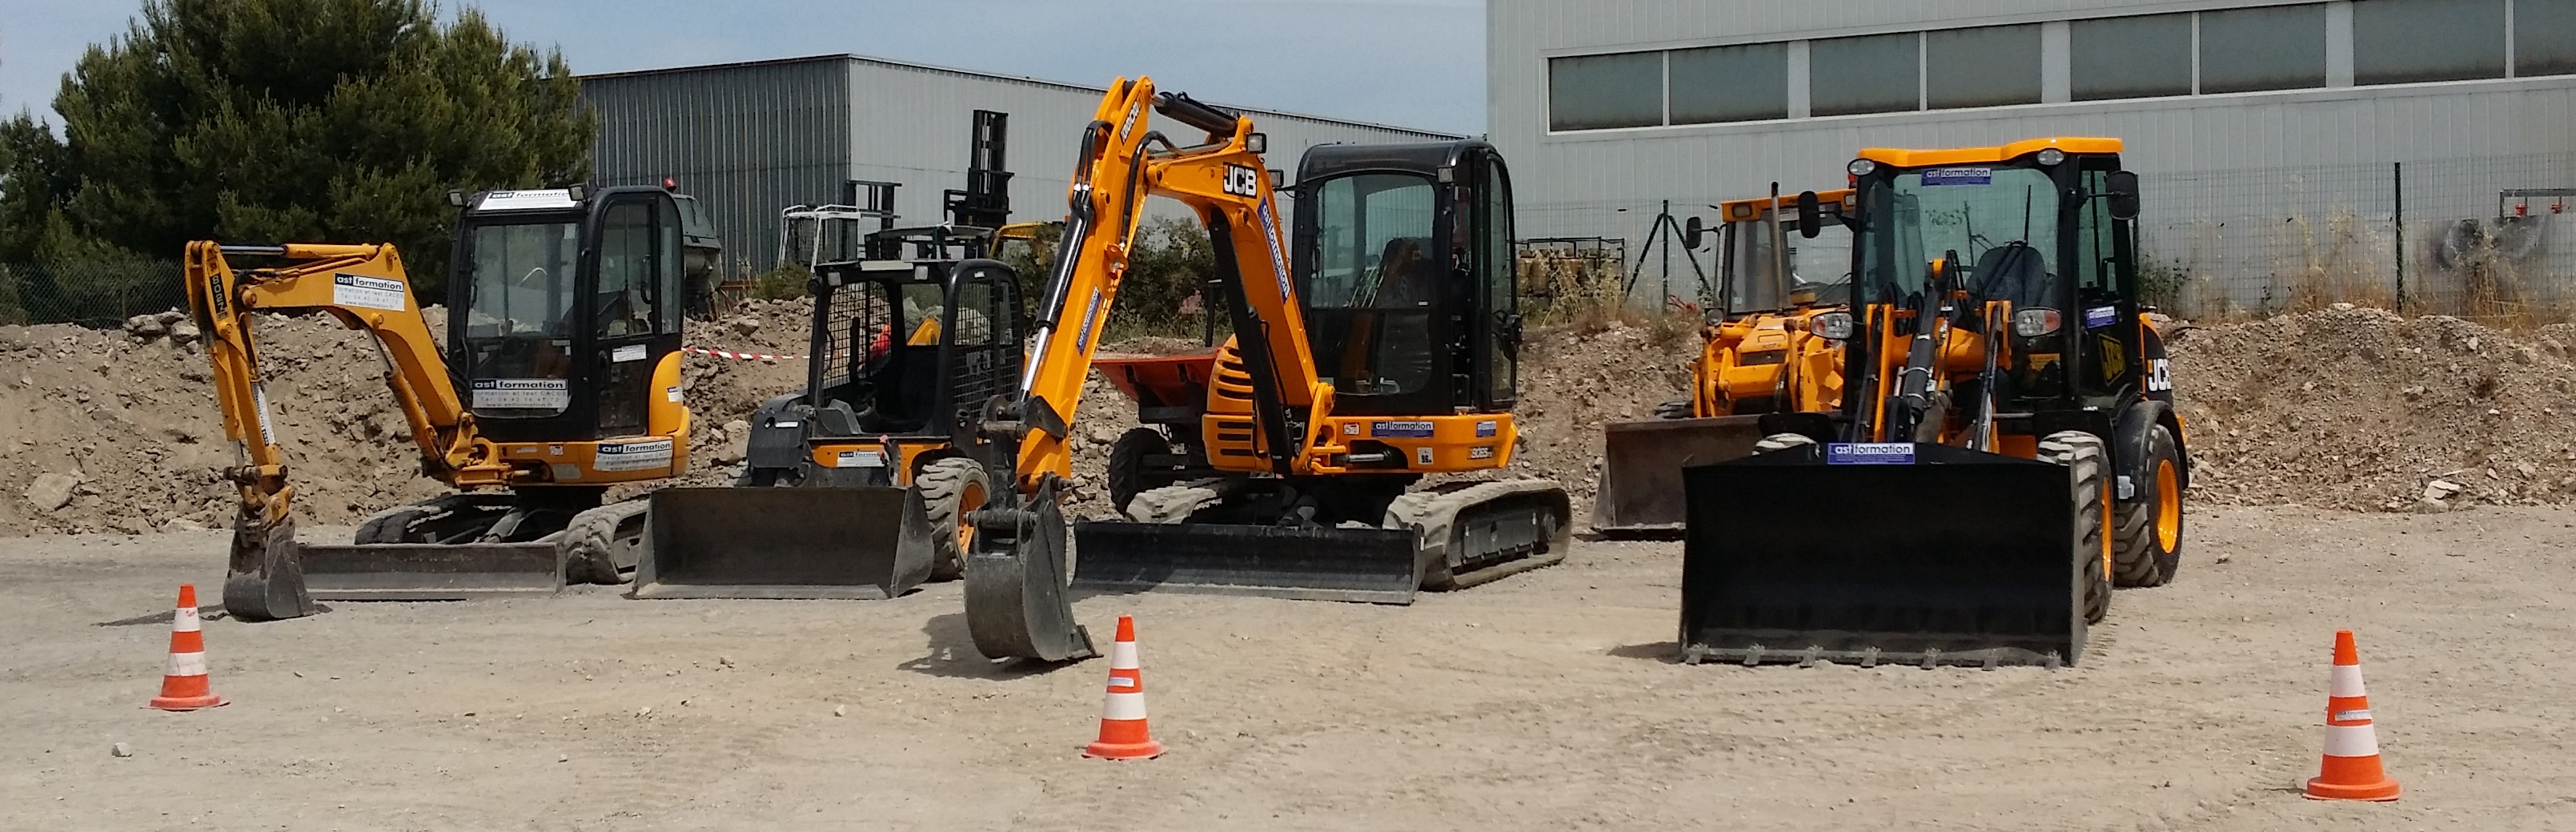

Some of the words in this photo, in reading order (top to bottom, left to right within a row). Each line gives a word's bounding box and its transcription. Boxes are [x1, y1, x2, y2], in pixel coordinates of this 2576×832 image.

[1942, 167, 1988, 177] formation
[1224, 164, 1258, 197] JCB
[1267, 223, 1289, 294] formation
[336, 275, 352, 284] ast
[355, 277, 403, 291] formation
[475, 380, 496, 388] ast
[499, 380, 564, 388] formation
[1390, 421, 1431, 430] formation
[602, 445, 623, 453] ast
[626, 442, 671, 452] formation
[1855, 444, 1911, 454] formation
